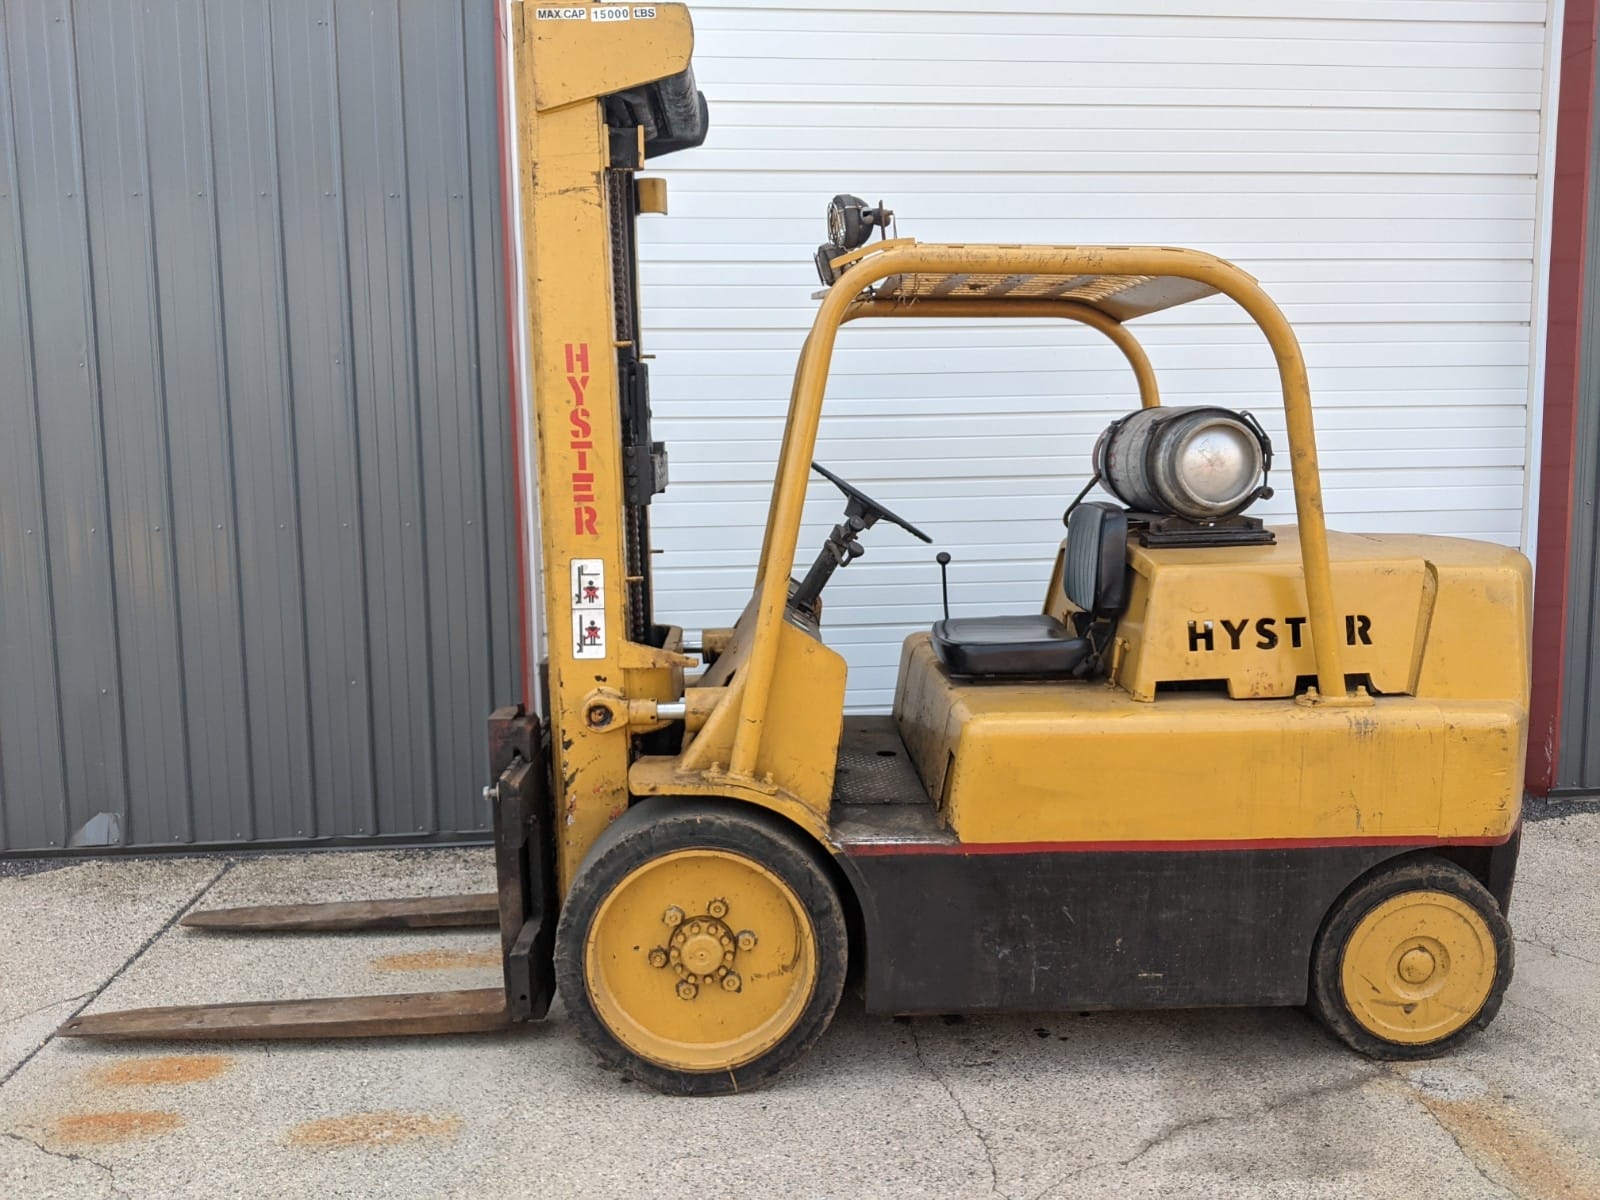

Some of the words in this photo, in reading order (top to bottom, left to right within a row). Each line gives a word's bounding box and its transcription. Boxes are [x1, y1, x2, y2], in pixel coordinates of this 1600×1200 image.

[538, 10, 561, 18] MAX
[563, 9, 585, 18] CAP
[593, 9, 629, 19] 15000
[634, 8, 655, 17] LBS
[565, 343, 598, 535] HYSTER
[1187, 614, 1373, 651] HYSTR
